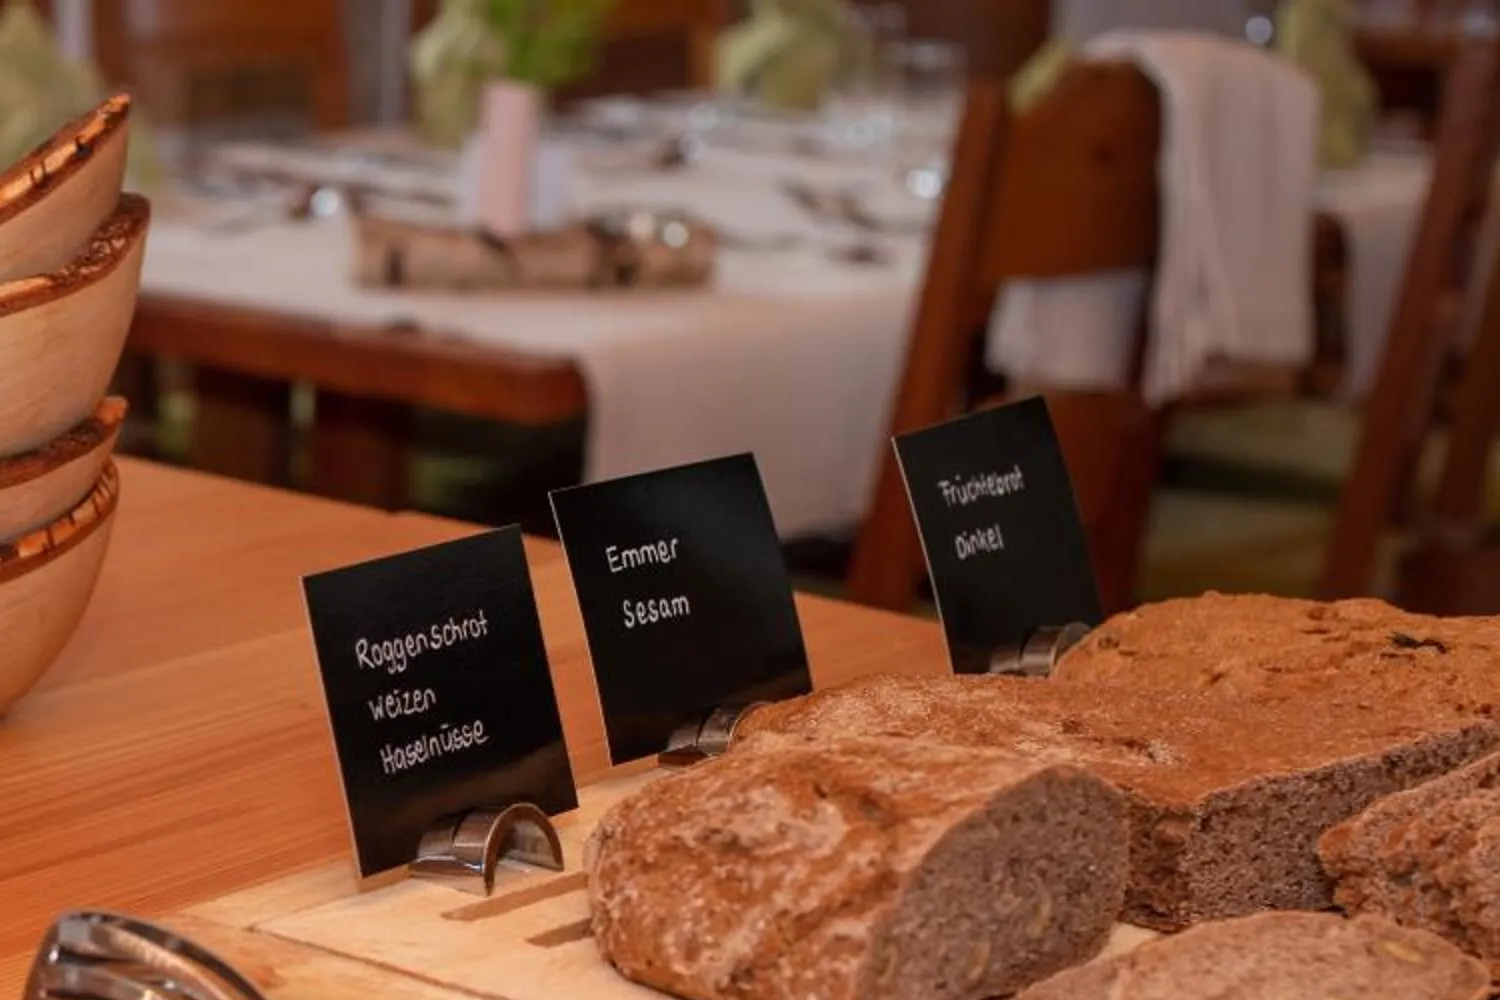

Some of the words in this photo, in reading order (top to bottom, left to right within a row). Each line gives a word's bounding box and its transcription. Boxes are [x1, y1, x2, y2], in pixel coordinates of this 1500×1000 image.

[605, 537, 679, 573] Emmer
[955, 524, 1004, 560] Dinkel
[623, 595, 690, 629] Sesam
[380, 718, 489, 775] Haselnüsse
